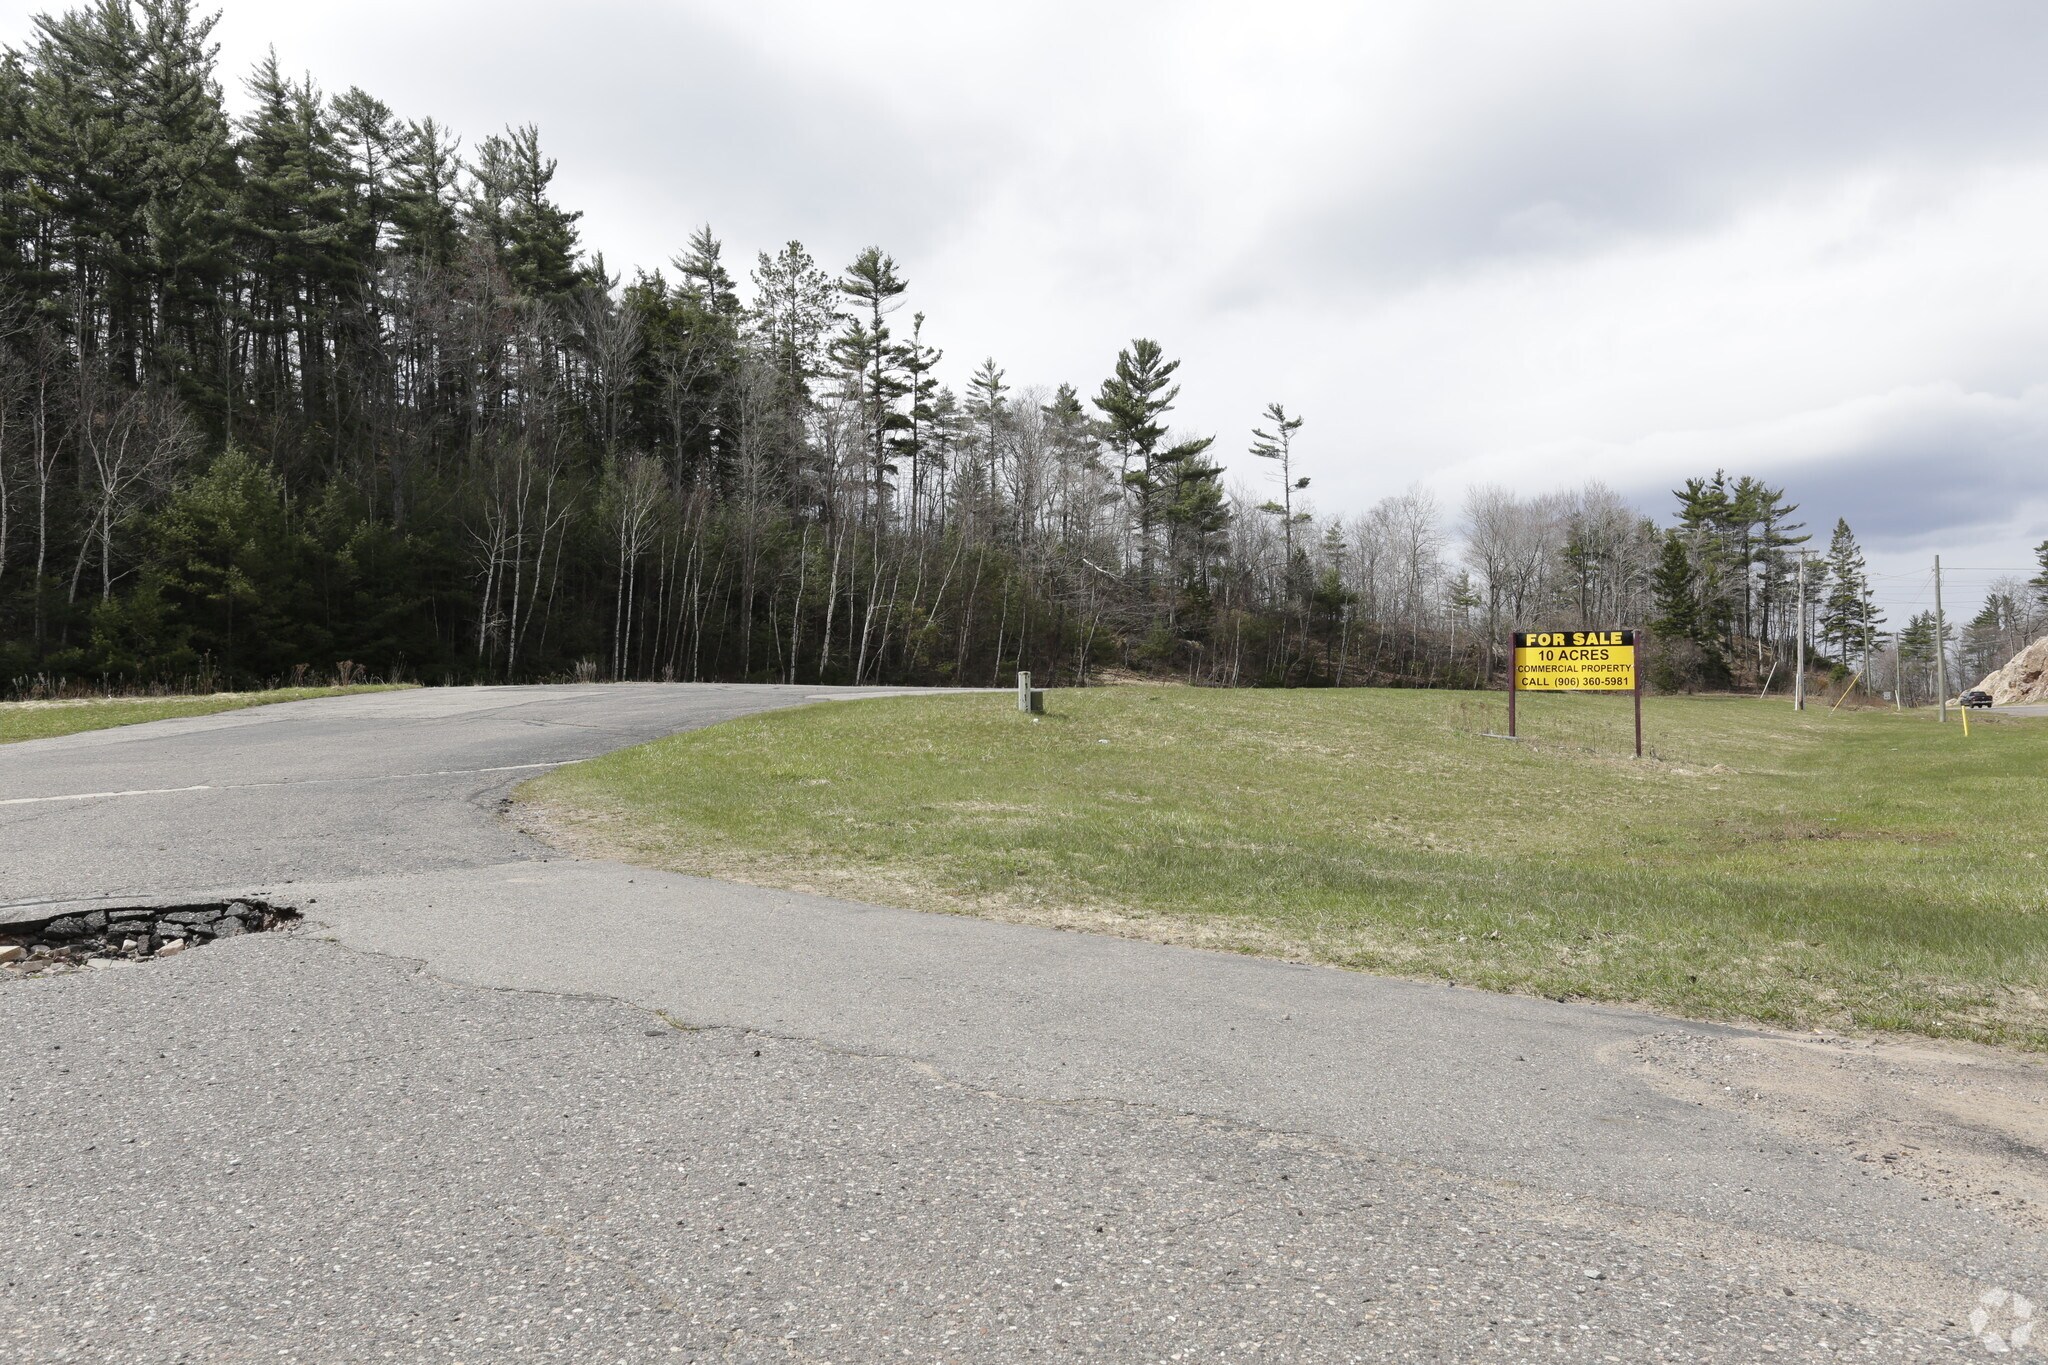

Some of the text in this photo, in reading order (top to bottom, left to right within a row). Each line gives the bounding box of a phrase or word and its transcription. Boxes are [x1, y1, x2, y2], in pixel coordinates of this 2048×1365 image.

[1526, 632, 1623, 646] FOR SALE
[1538, 649, 1609, 661] 10 ACRES
[1517, 664, 1632, 673] COMMERCIAL PROPERTY
[1521, 677, 1628, 688] CALL (906) 360-5981
